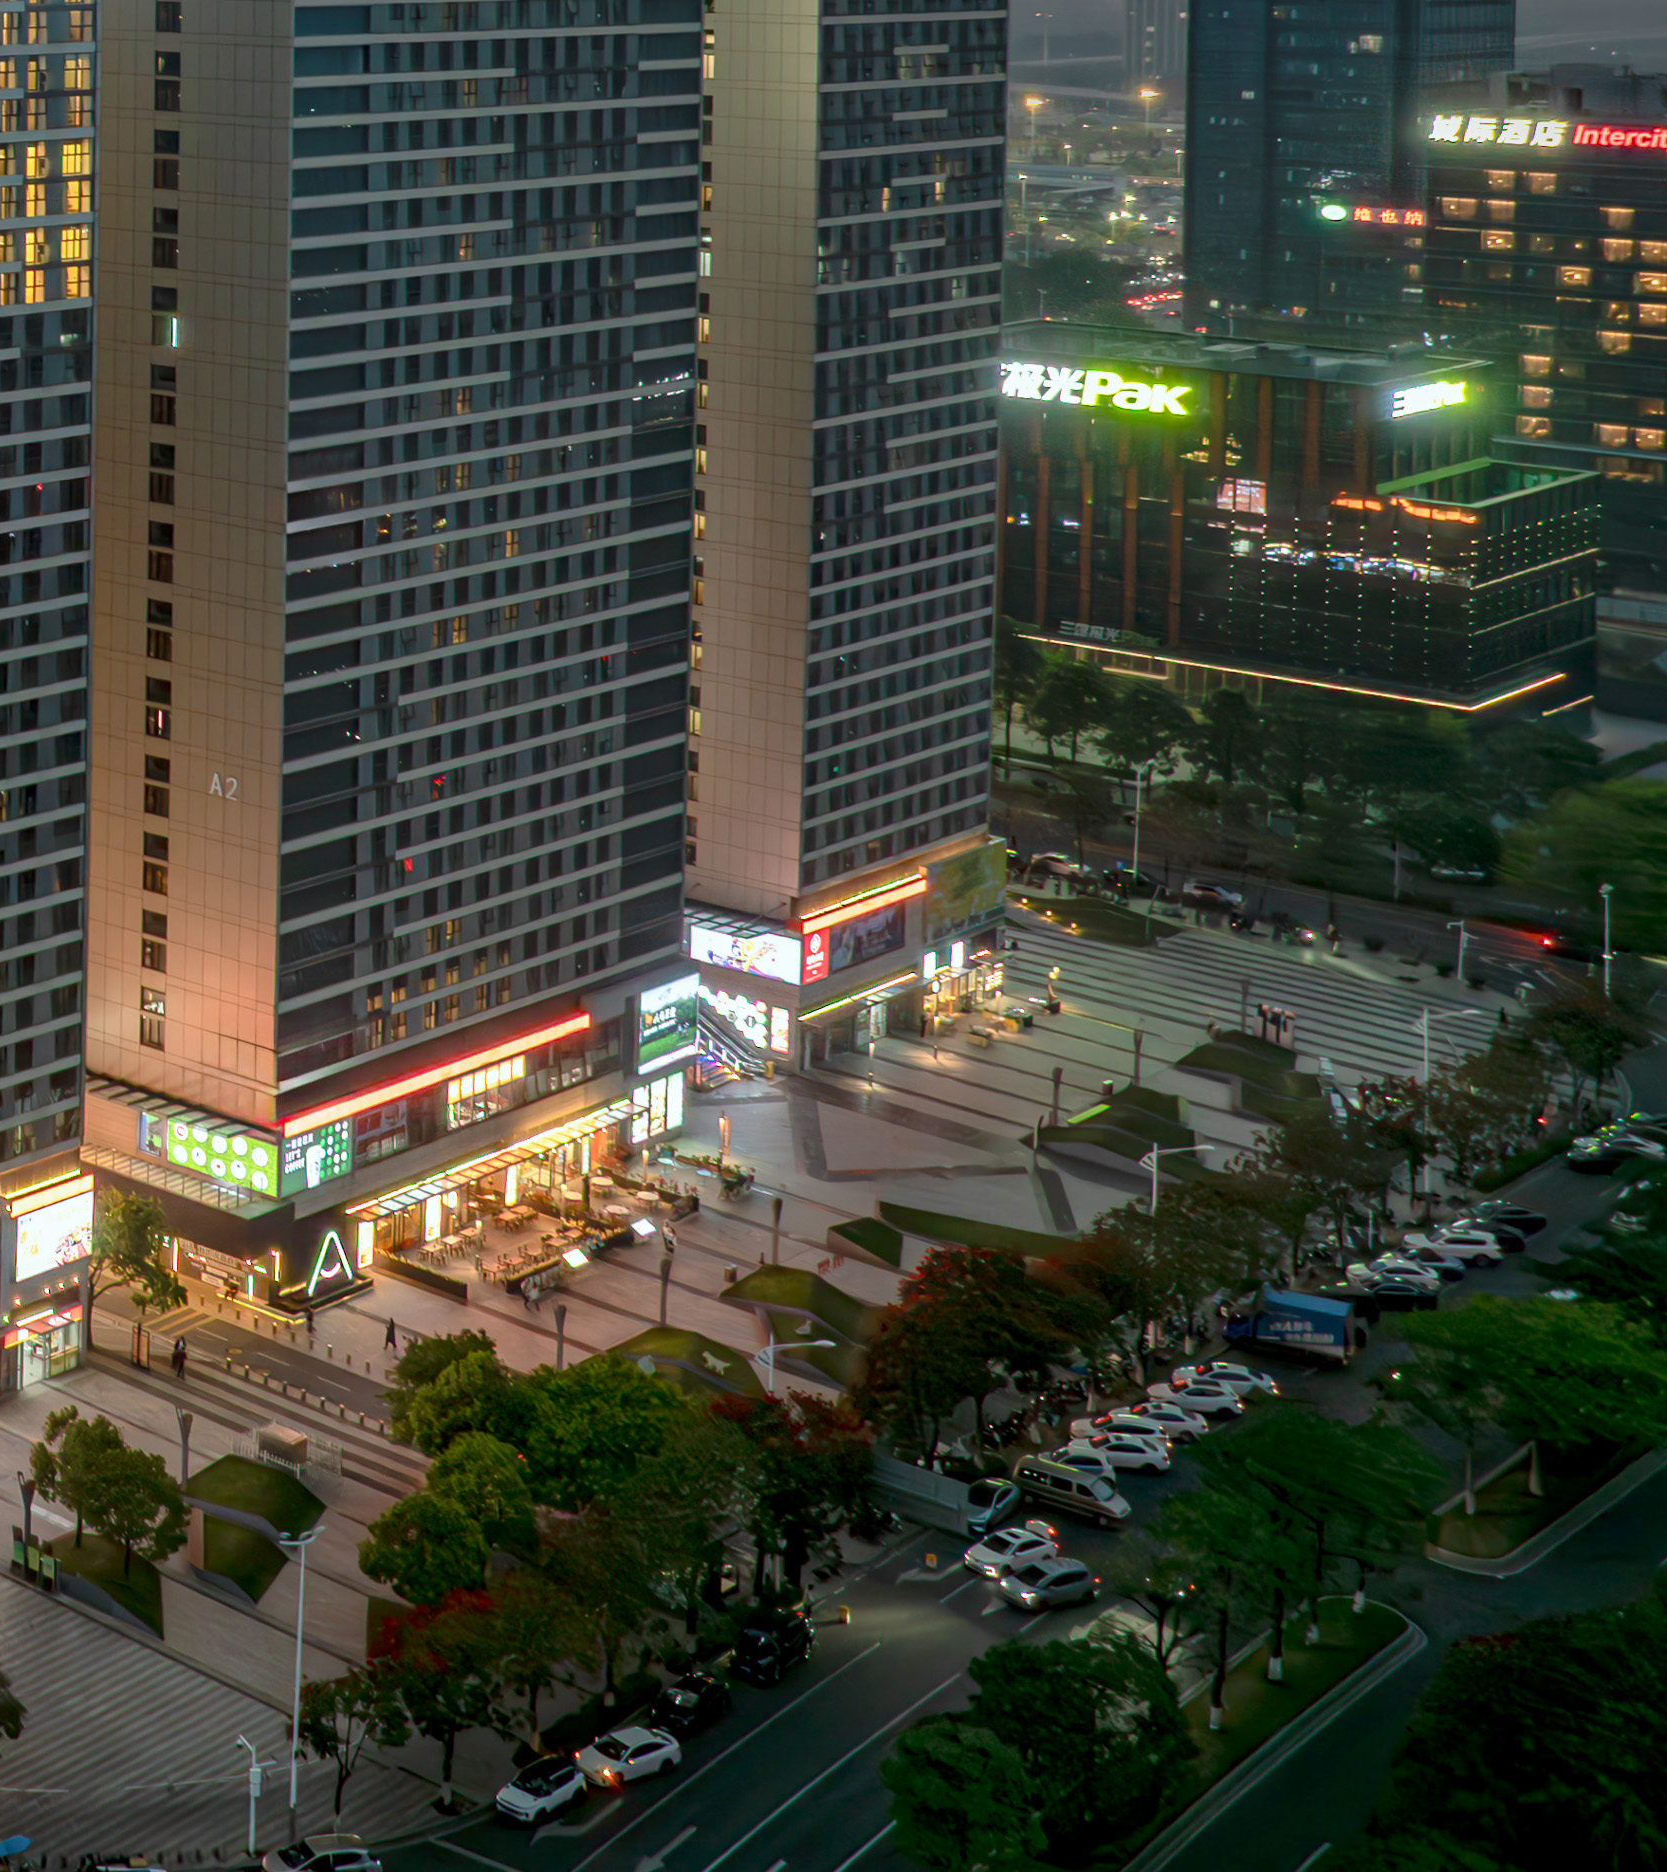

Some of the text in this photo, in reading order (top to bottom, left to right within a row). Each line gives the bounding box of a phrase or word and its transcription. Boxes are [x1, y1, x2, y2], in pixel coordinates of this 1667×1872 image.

[1428, 114, 1667, 154] 城际酒店 Intercit
[1353, 206, 1424, 226] 维也纳
[209, 772, 238, 802] A2
